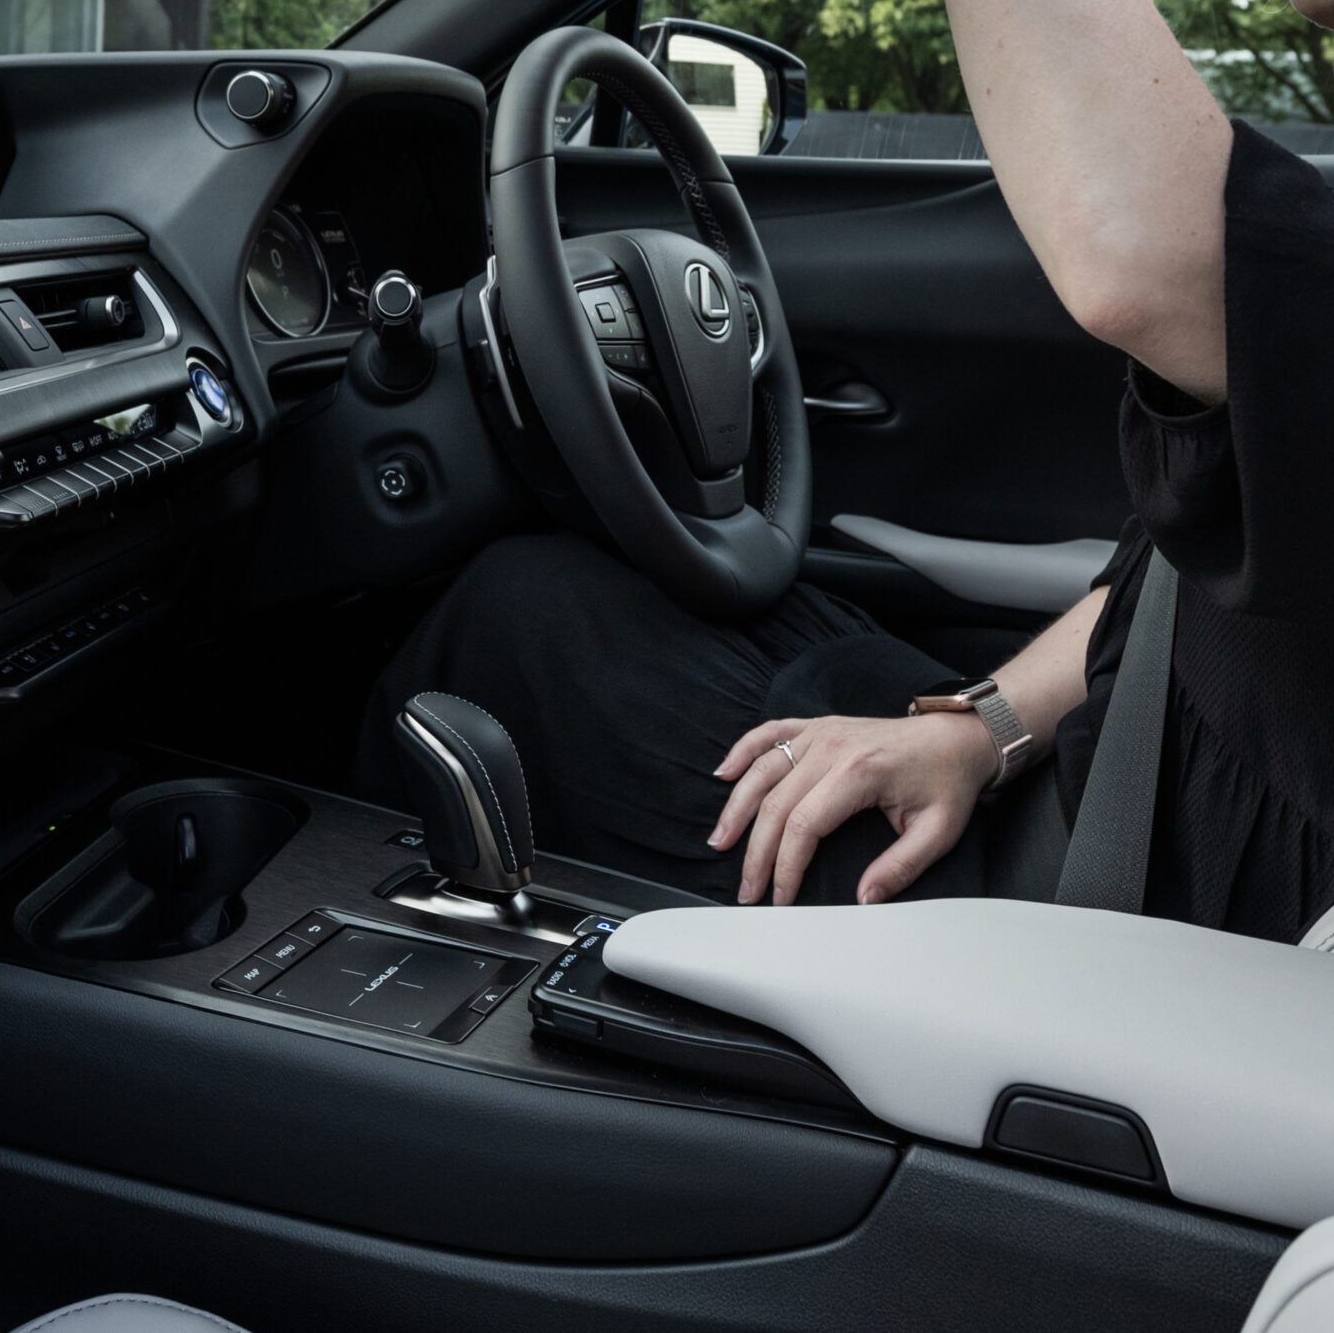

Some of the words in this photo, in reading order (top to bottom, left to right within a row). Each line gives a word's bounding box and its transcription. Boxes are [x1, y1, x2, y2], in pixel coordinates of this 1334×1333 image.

[270, 248, 283, 269] 0
[596, 922, 616, 933] P
[581, 936, 600, 949] MEDIA
[275, 944, 296, 959] MENU
[244, 968, 260, 981] MAP
[365, 966, 399, 992] LEXUS
[547, 971, 564, 986] RADIO
